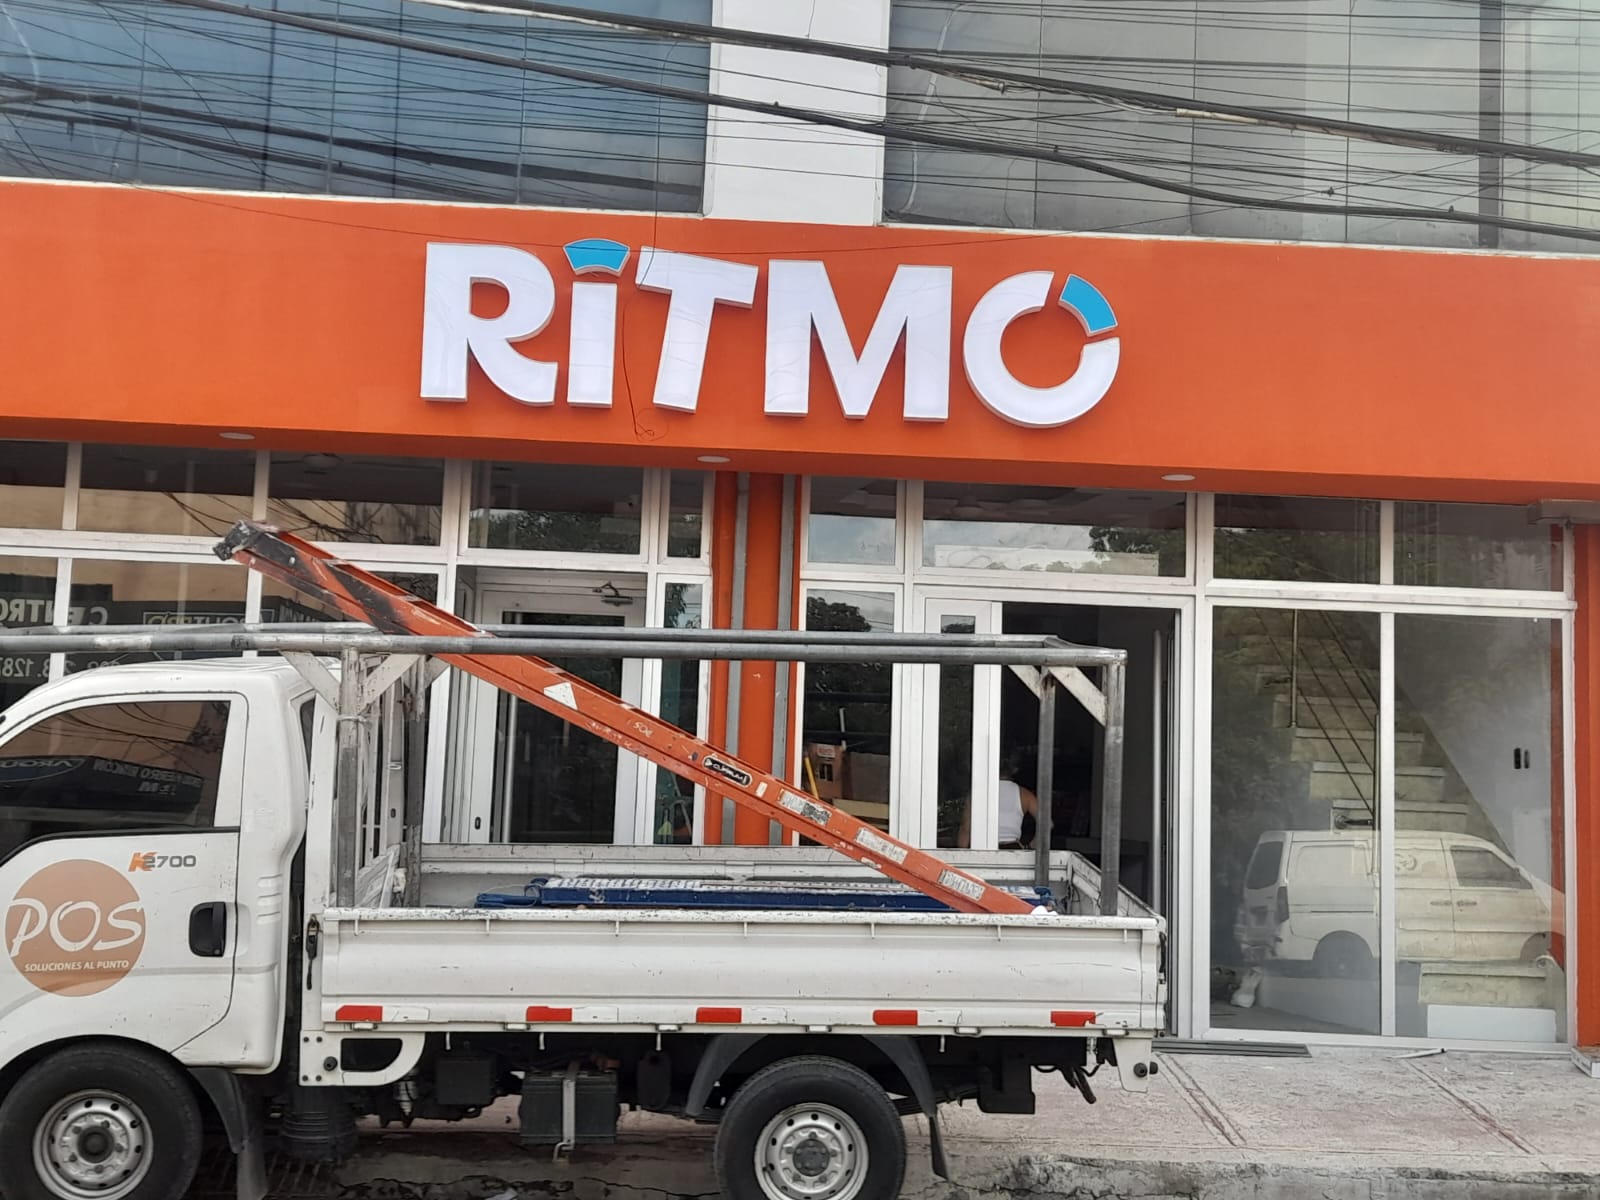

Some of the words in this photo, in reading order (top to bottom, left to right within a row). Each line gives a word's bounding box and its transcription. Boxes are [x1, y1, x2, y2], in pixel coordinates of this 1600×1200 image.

[129, 852, 197, 871] K2700
[9, 898, 143, 957] POS
[24, 960, 82, 971] SOLUCIONES
[83, 961, 95, 970] AL
[96, 959, 129, 969] PUNTO
